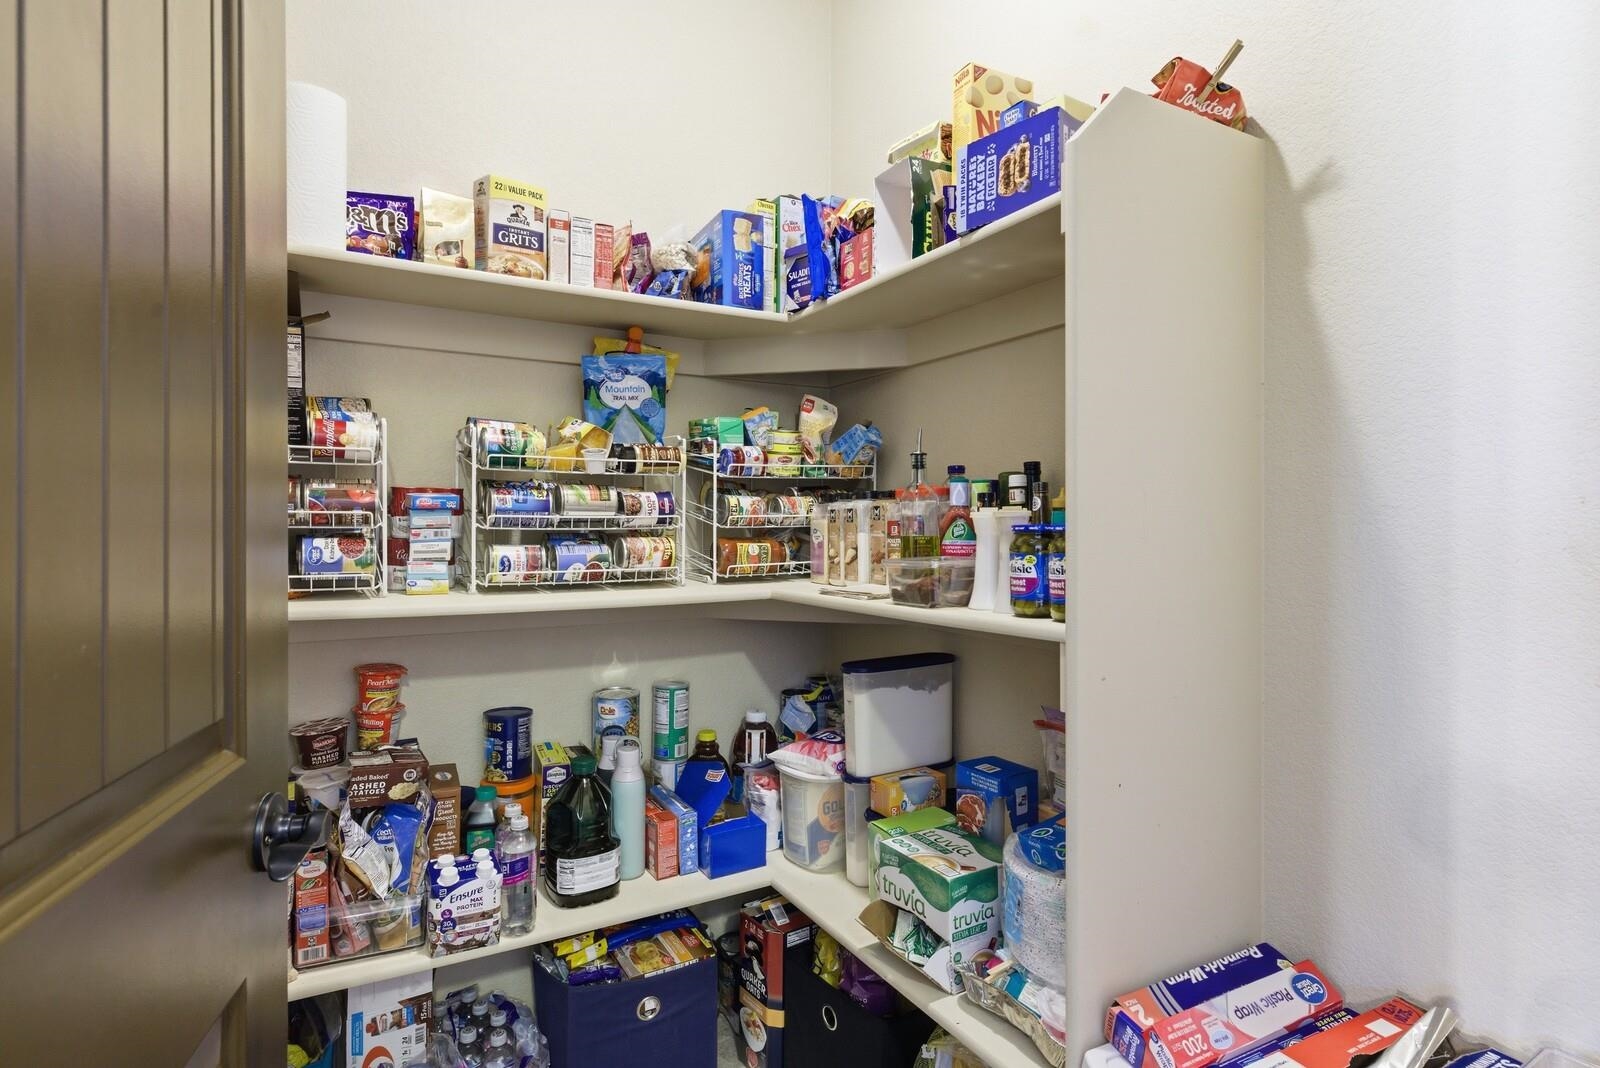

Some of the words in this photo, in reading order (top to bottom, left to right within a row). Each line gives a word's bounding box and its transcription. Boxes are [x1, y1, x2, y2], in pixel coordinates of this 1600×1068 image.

[912, 159, 919, 173] 24
[987, 158, 995, 178] BAR
[494, 182, 503, 191] 22
[508, 185, 527, 197] VALUE
[528, 190, 543, 201] PACK
[977, 154, 985, 211] BAKERY
[987, 181, 995, 197] FIG
[498, 230, 539, 249] GRITS
[743, 264, 752, 298] TREATS
[605, 385, 645, 394] Mountain
[600, 706, 616, 714] Dole
[312, 752, 339, 761] MASHED
[450, 886, 484, 904] Ensure
[457, 902, 484, 911] PROTEIN
[741, 968, 766, 996] QUAKER
[746, 981, 760, 999] OATS
[1299, 982, 1323, 1000] Great
[1259, 987, 1294, 1012] Plastic
[1128, 1003, 1155, 1025] 2
[1234, 1001, 1262, 1022] Wrap
[1180, 1033, 1208, 1057] 200
